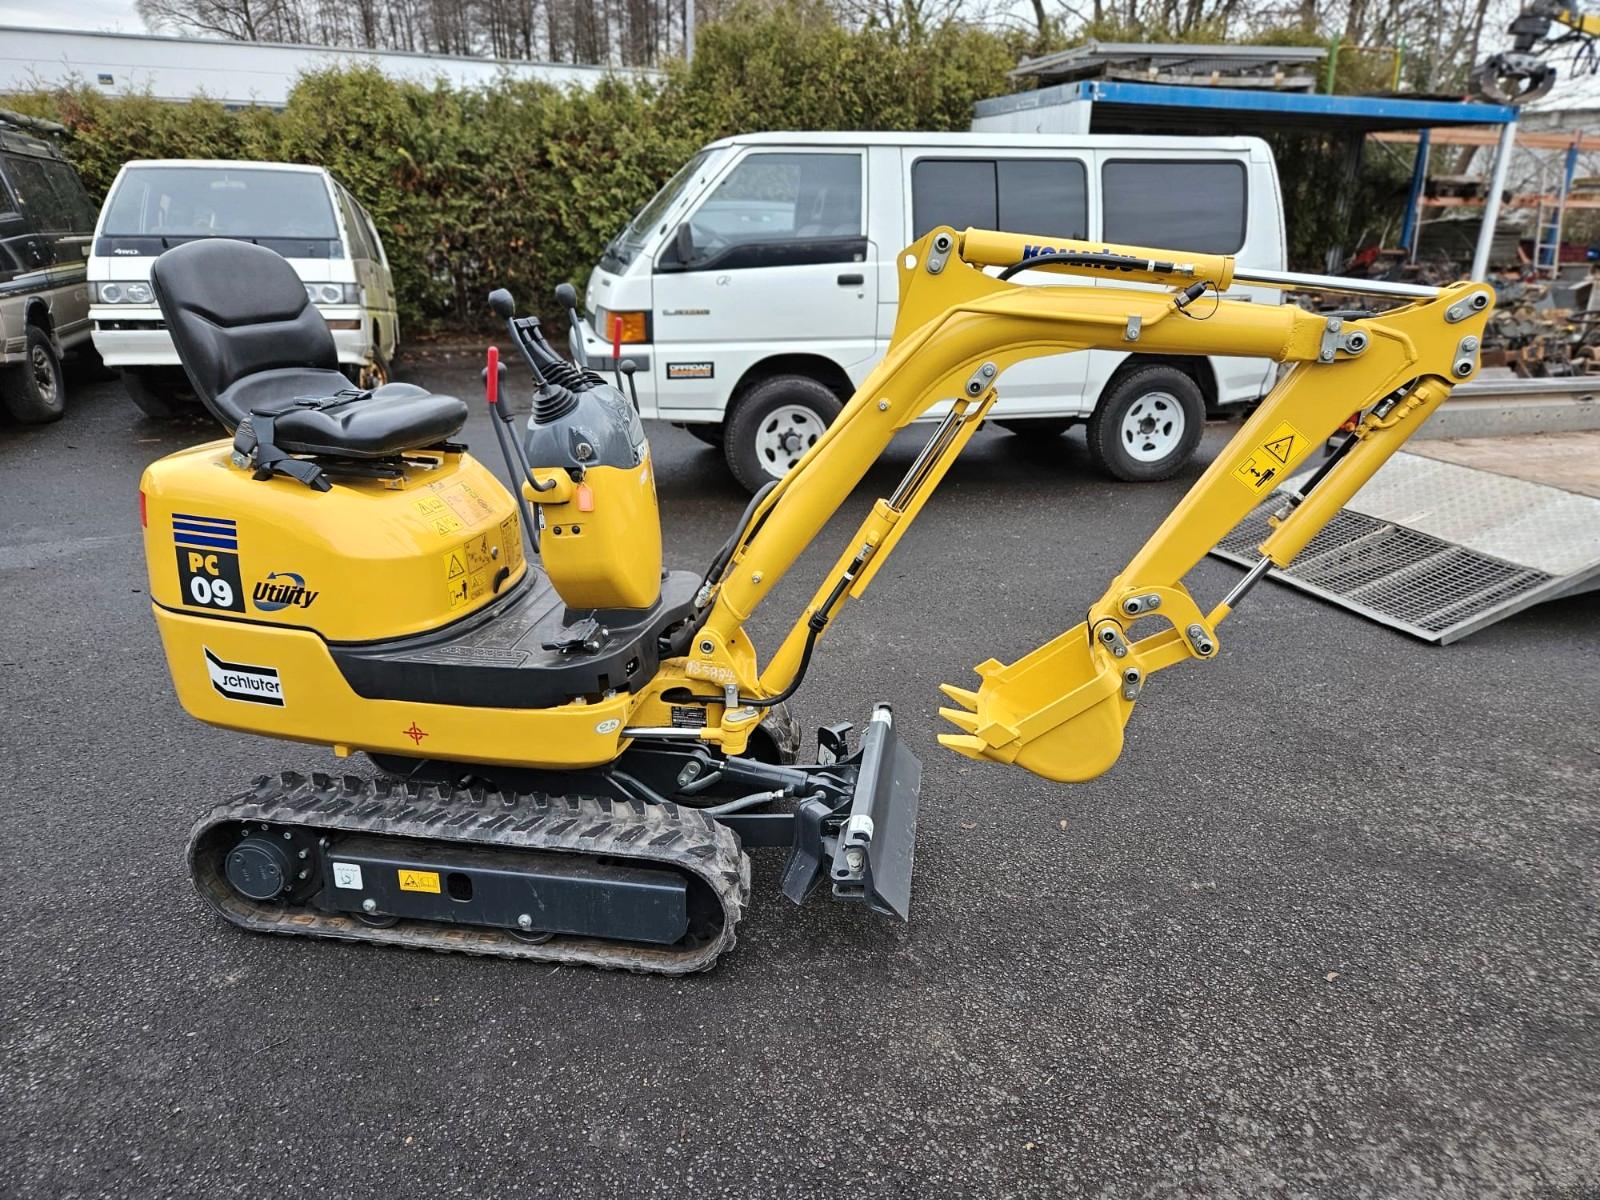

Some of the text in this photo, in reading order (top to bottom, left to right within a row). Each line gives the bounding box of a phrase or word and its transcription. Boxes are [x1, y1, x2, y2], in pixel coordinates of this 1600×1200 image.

[188, 552, 219, 576] PC
[190, 576, 234, 608] 09
[252, 582, 319, 609] Utility
